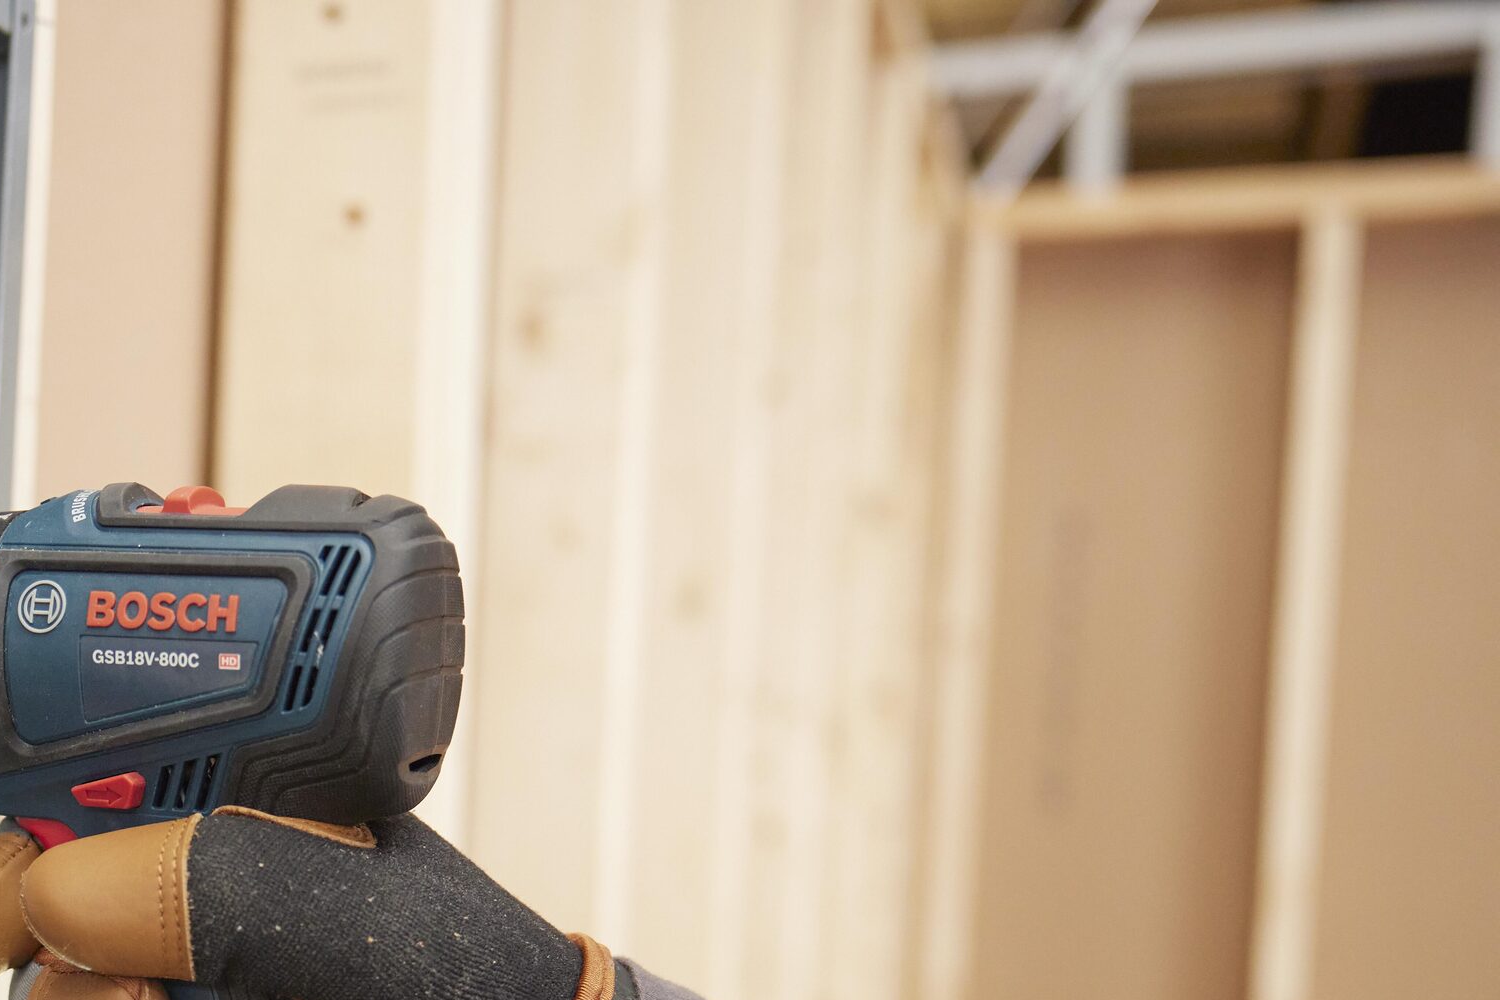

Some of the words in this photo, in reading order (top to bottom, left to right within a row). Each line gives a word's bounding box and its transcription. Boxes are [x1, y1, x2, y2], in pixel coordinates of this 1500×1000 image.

[86, 590, 240, 634] BOSCH
[92, 649, 200, 669] GSB18V-800C
[220, 656, 238, 668] HD
